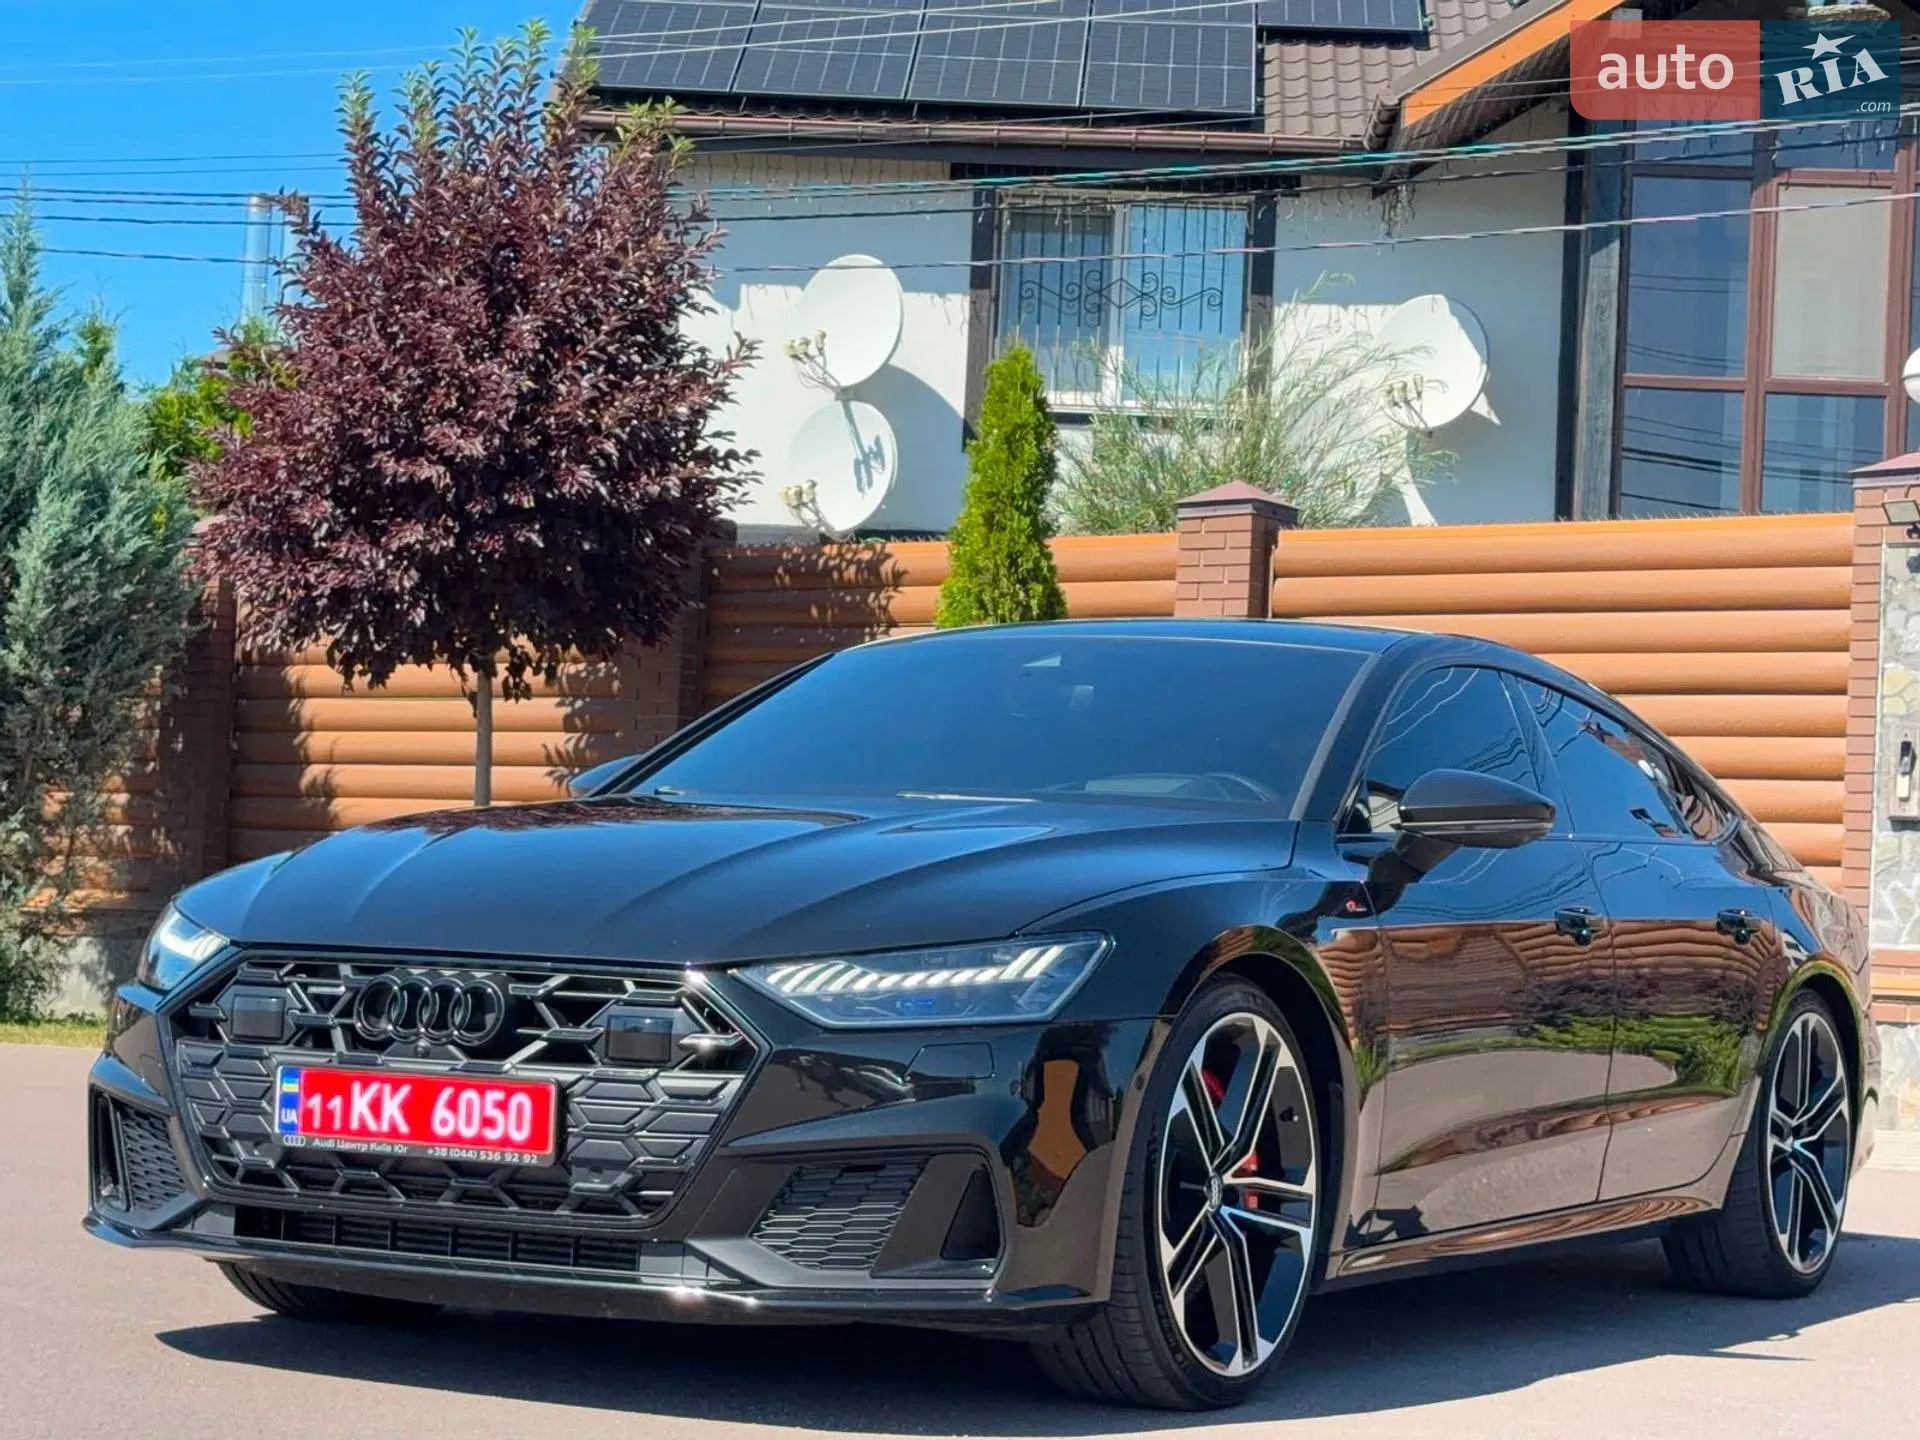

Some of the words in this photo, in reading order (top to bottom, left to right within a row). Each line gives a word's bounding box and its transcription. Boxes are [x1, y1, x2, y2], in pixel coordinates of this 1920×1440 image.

[281, 1108, 298, 1124] UA
[431, 1086, 532, 1142] 6050
[312, 1137, 336, 1148] Audi
[336, 1139, 368, 1152] Центр
[449, 1147, 477, 1160] (044)
[479, 1150, 501, 1161] 536
[503, 1152, 520, 1163] 92
[522, 1153, 539, 1164] 92
